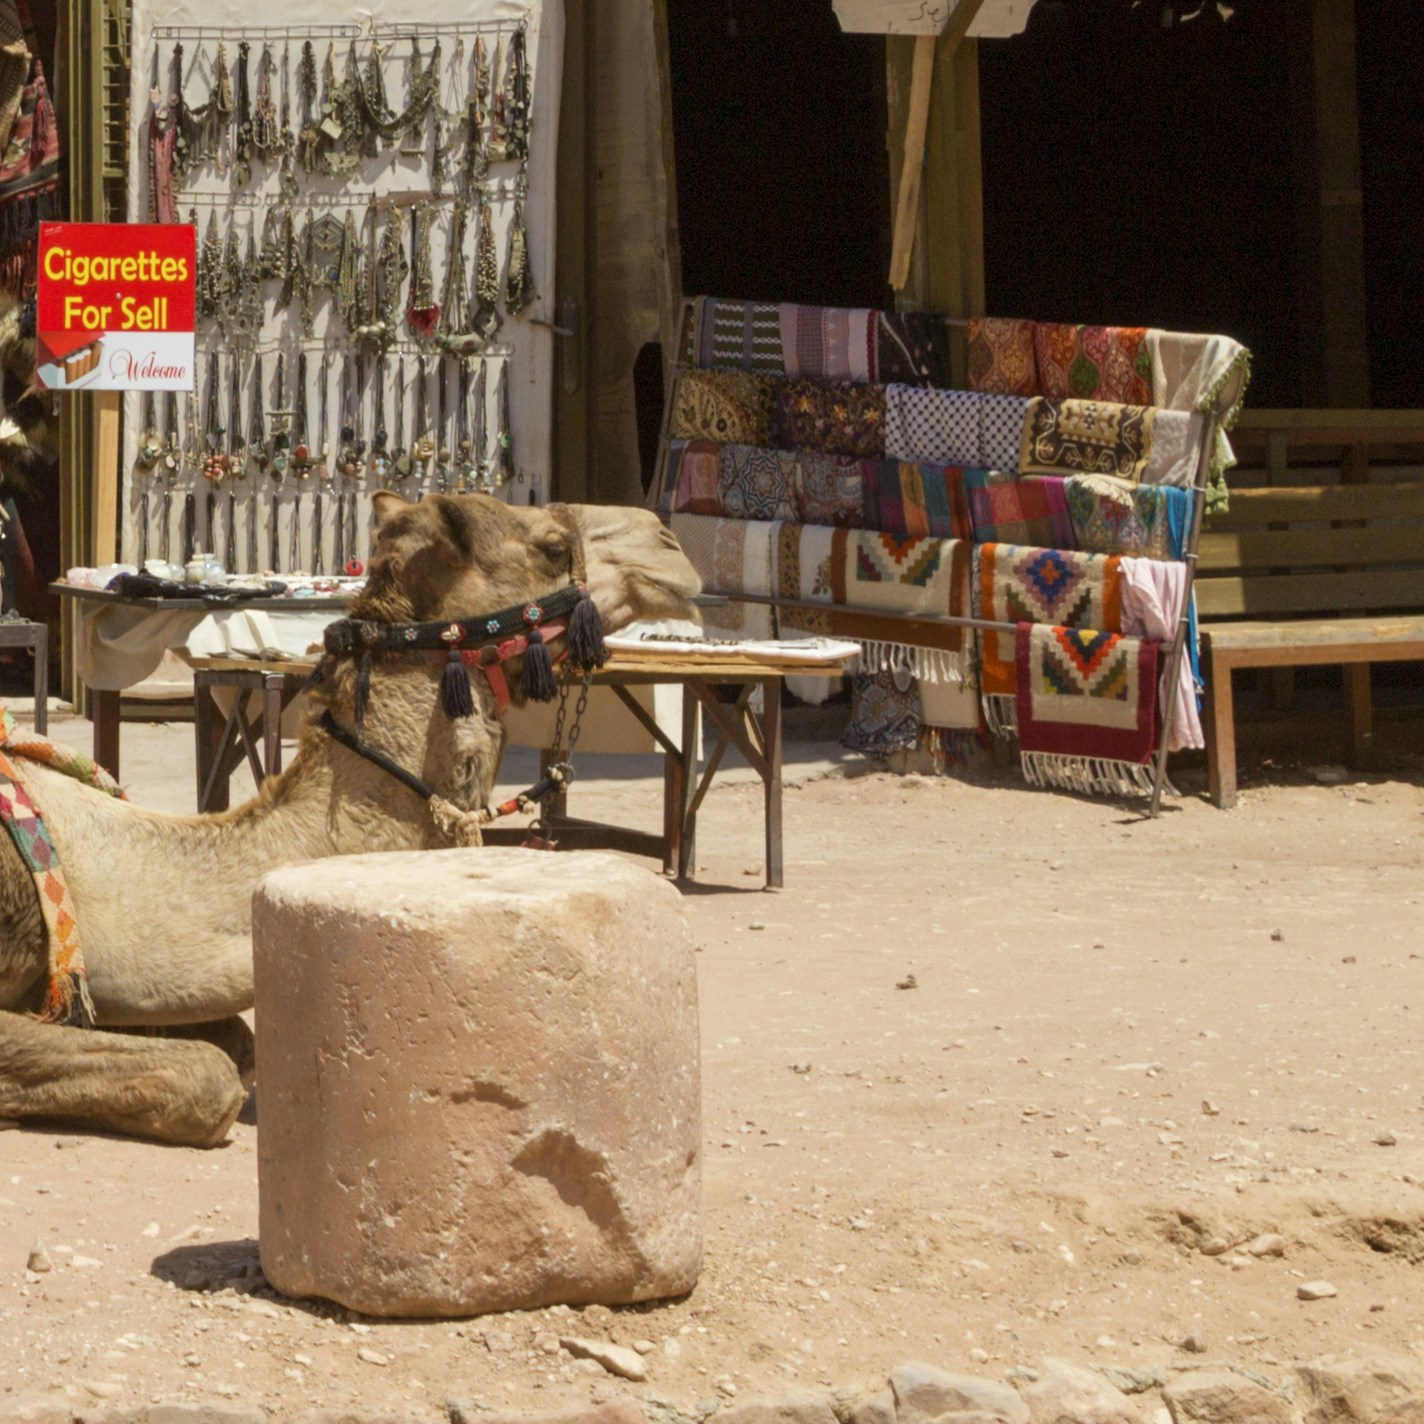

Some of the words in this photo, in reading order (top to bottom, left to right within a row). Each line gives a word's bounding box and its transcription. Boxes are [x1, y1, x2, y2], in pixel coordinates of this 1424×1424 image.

[44, 246, 188, 286] Cigarettes
[65, 296, 112, 329] For
[121, 297, 168, 330] Sell
[109, 348, 186, 382] Welcome
